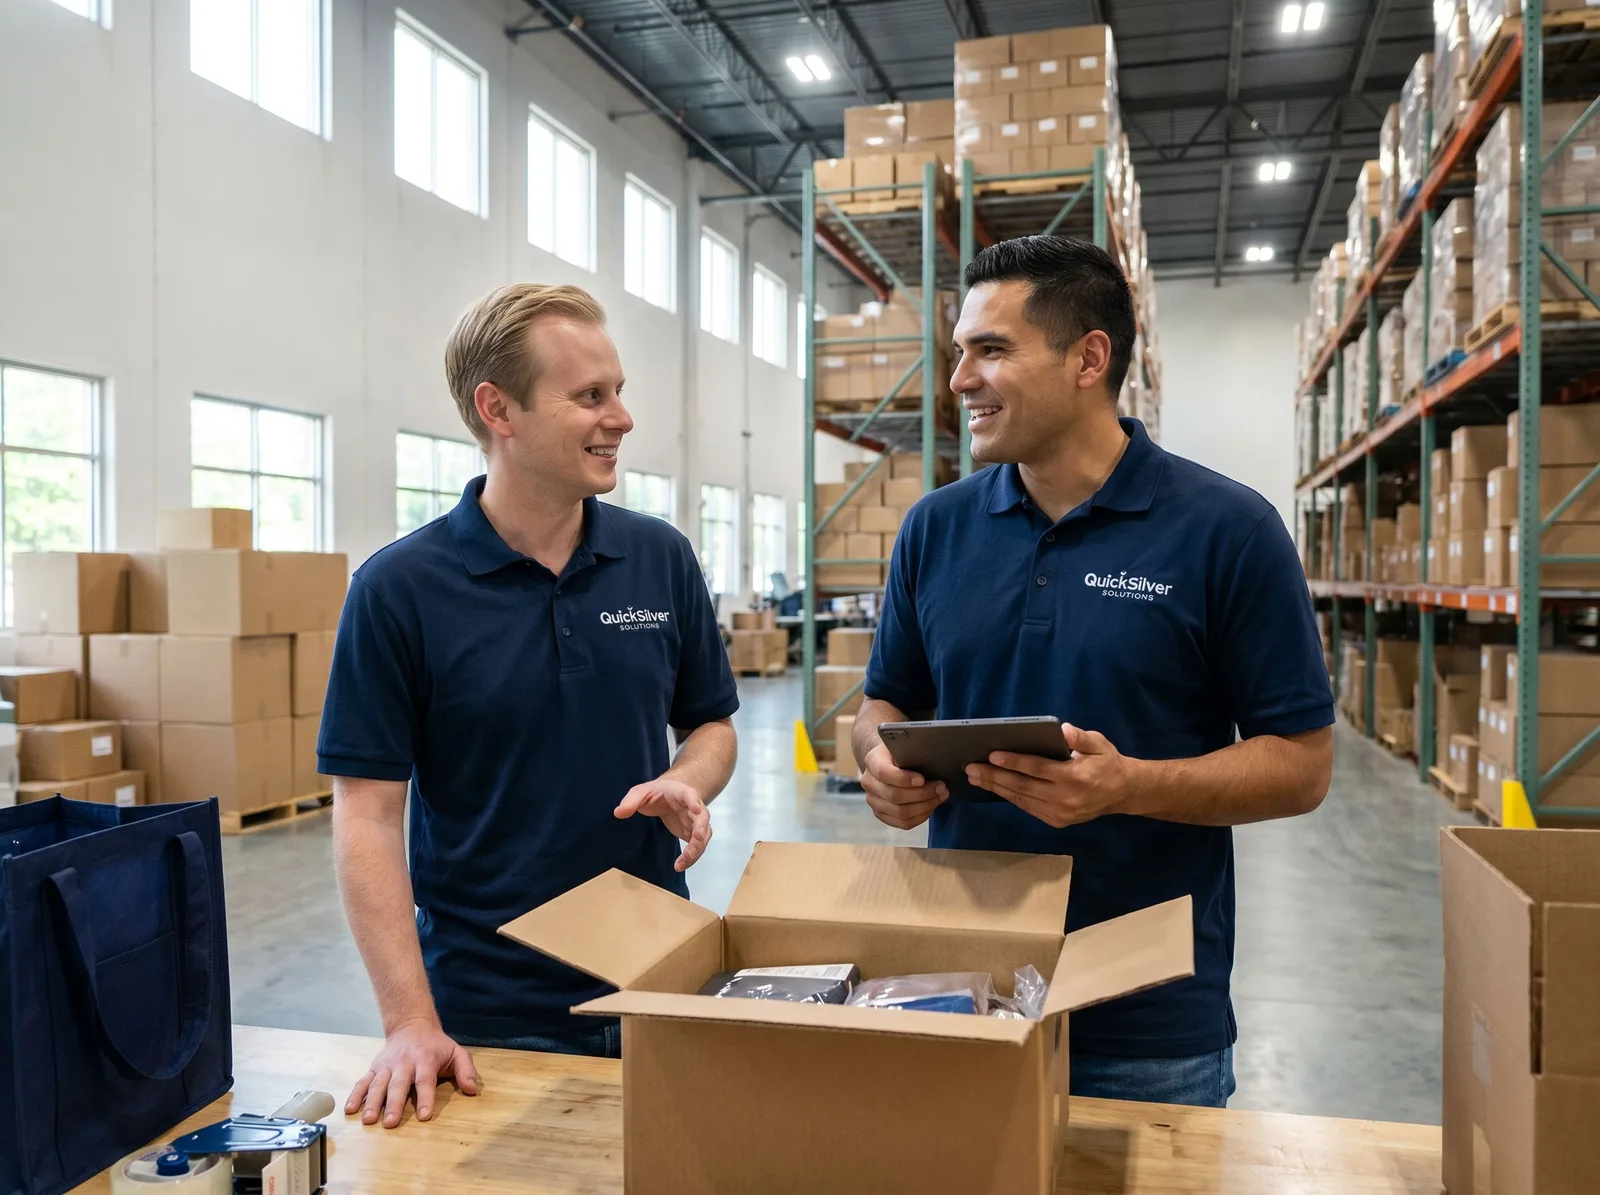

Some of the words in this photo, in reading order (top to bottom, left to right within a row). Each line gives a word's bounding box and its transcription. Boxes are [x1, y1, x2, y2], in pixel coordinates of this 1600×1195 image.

[1084, 572, 1173, 596] QuickSilver
[1102, 589, 1154, 602] SOLUTIONS
[600, 607, 670, 625] QuickSilver
[619, 622, 660, 632] SOLUTIONS
